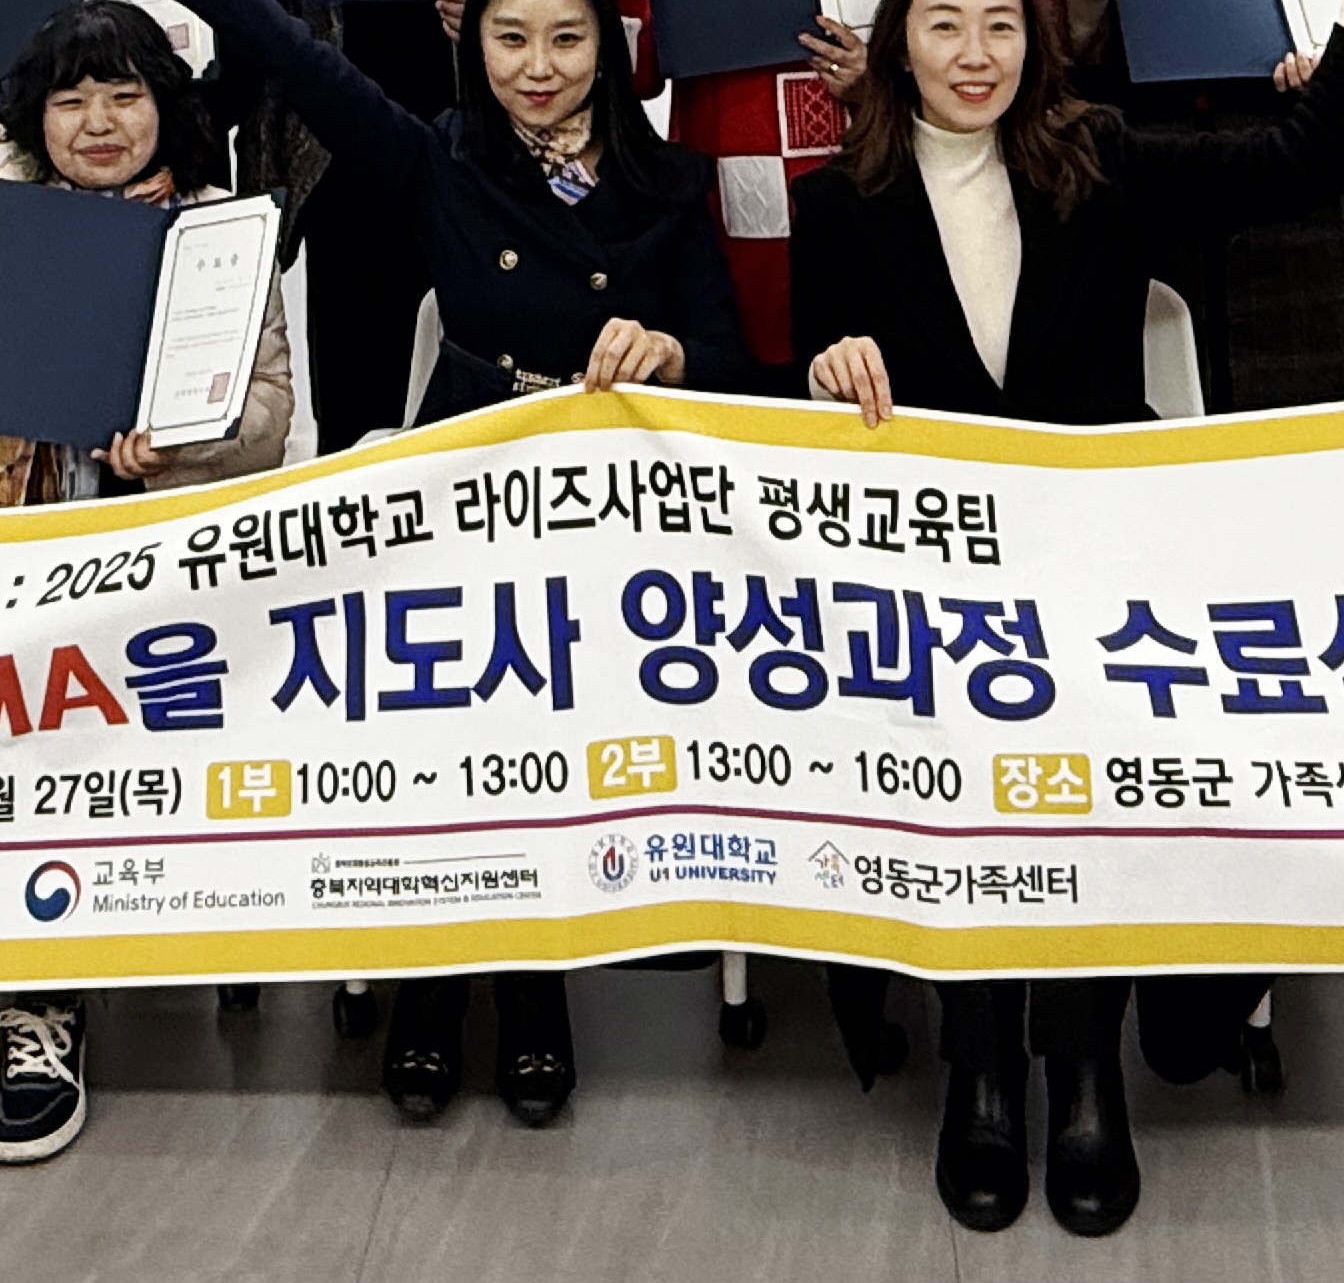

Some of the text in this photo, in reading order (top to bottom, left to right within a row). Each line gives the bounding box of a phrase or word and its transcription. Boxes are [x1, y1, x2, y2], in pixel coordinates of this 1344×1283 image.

[35, 541, 162, 609] 2025
[179, 488, 435, 591] 유원대학교
[452, 459, 736, 545] 라이즈사업단
[757, 474, 1003, 567] 평생교육팀
[269, 575, 582, 723] 지도사
[620, 567, 1057, 723] 양성과정
[33, 765, 183, 820] 27일(목)
[217, 762, 278, 814] 1부
[296, 758, 398, 806] 10:00
[458, 749, 570, 798] 13:00
[600, 737, 667, 788] 2부
[686, 739, 792, 787] 13:00
[854, 749, 963, 804] 16:00
[999, 756, 1089, 809] 장소
[1104, 756, 1235, 809] 영동군
[644, 832, 778, 866] 유원대학교
[92, 856, 167, 887] 교육부
[649, 865, 777, 886] U1 UNIVERSITY
[854, 855, 1079, 905] 영동군가족센터
[92, 887, 286, 916] Ministry of Education
